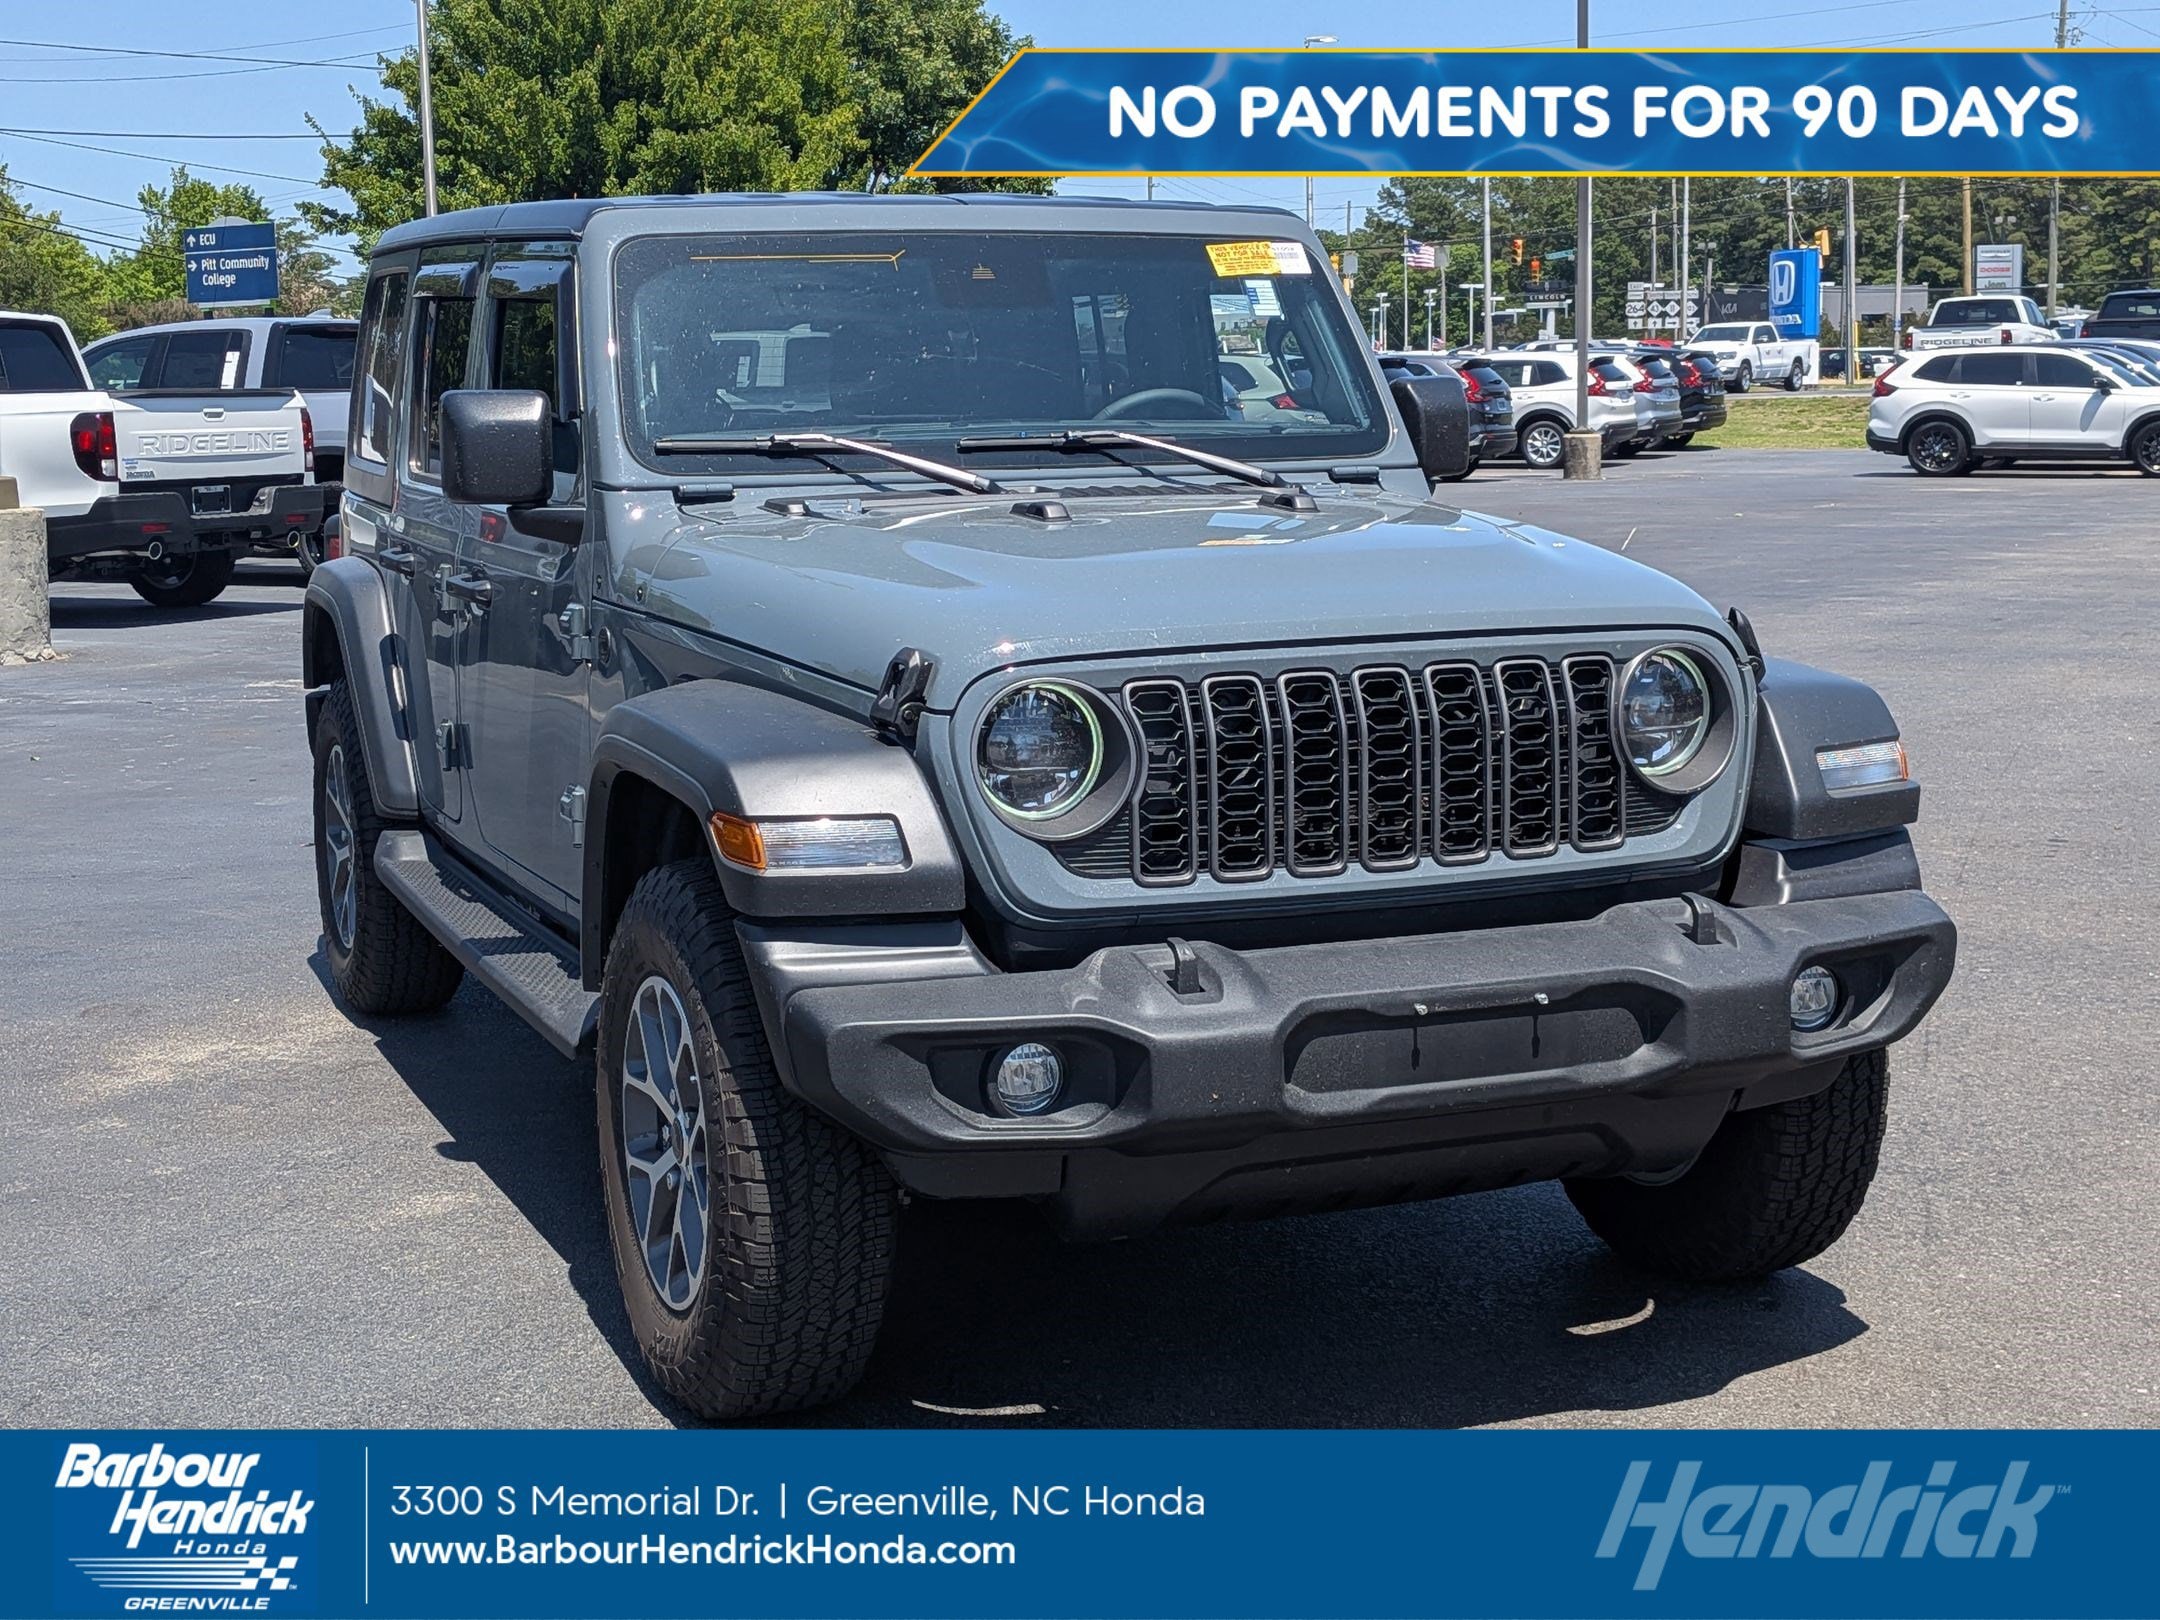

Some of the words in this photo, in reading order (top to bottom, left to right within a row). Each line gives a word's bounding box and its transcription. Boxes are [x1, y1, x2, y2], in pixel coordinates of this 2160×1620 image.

[199, 233, 216, 246] ECU
[201, 257, 217, 271] Pitt
[219, 254, 270, 271] Community
[202, 273, 237, 288] College
[1627, 304, 1646, 315] 264
[138, 431, 289, 456] RIDGELINE
